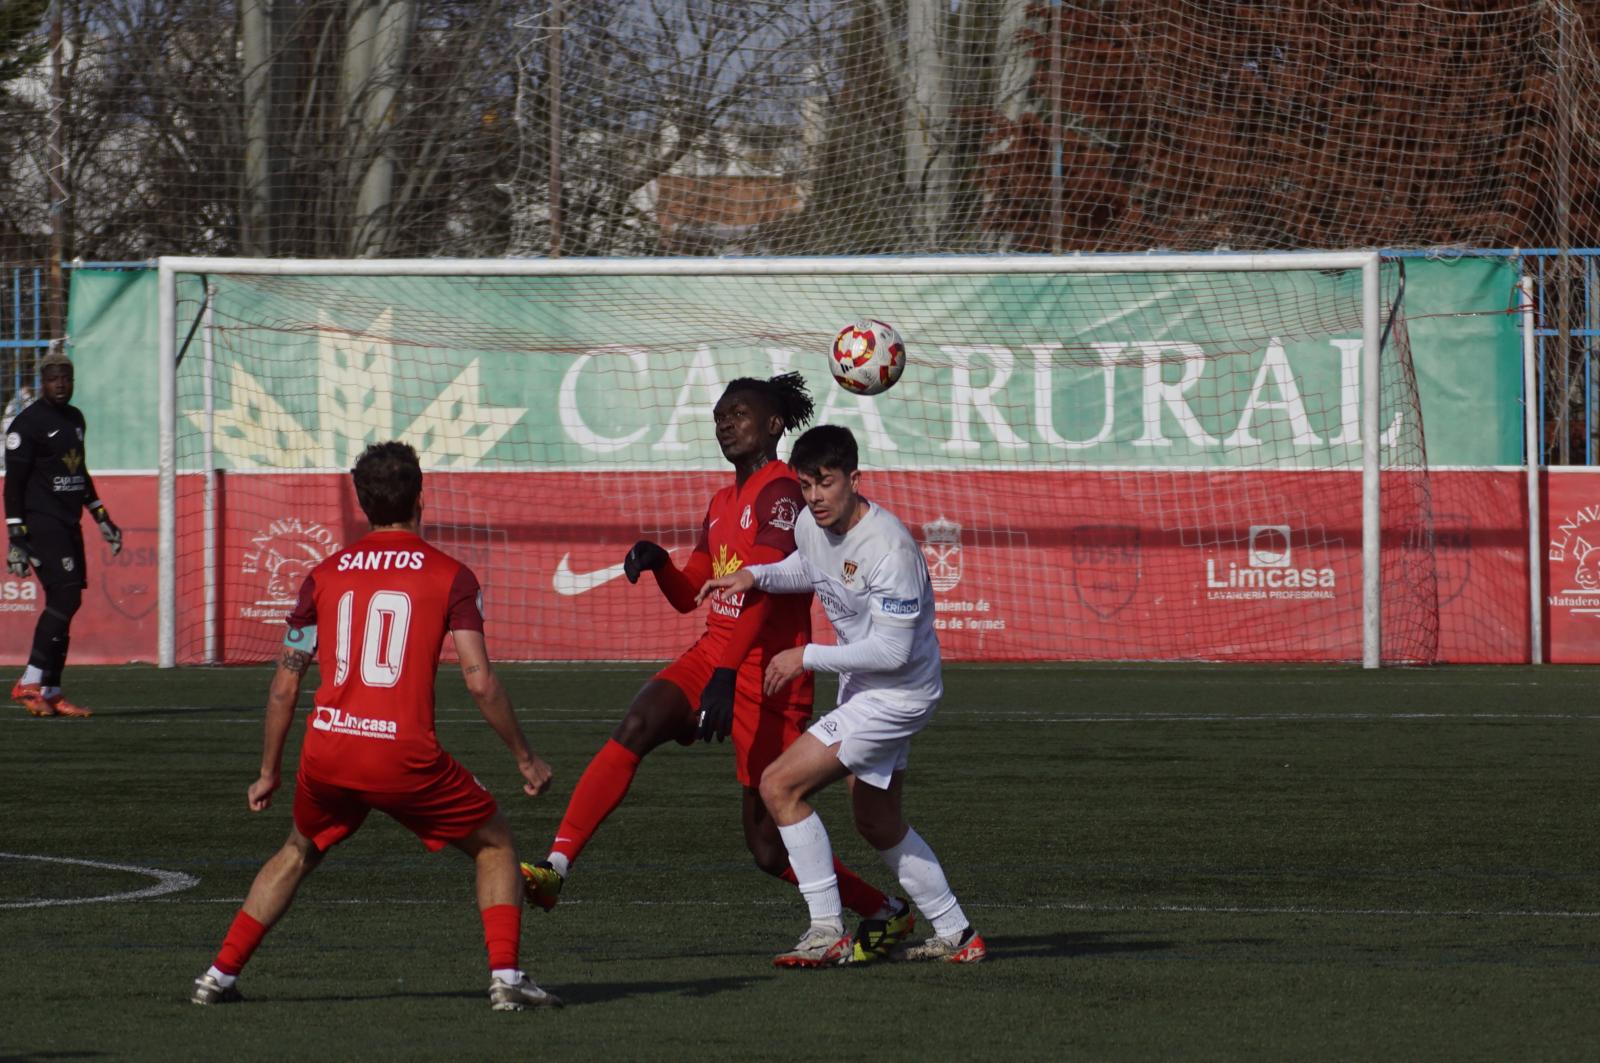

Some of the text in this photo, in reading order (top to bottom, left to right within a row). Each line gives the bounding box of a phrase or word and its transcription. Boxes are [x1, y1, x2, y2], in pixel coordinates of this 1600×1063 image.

[939, 337, 1404, 449] RURAL
[242, 550, 262, 573] EL
[337, 551, 424, 571] SANTOS
[1549, 538, 1569, 562] EL
[1207, 559, 1336, 588] Limcasa
[935, 600, 990, 612] miento de
[949, 618, 963, 630] de
[966, 618, 1005, 632] Tormes
[334, 590, 411, 688] 10
